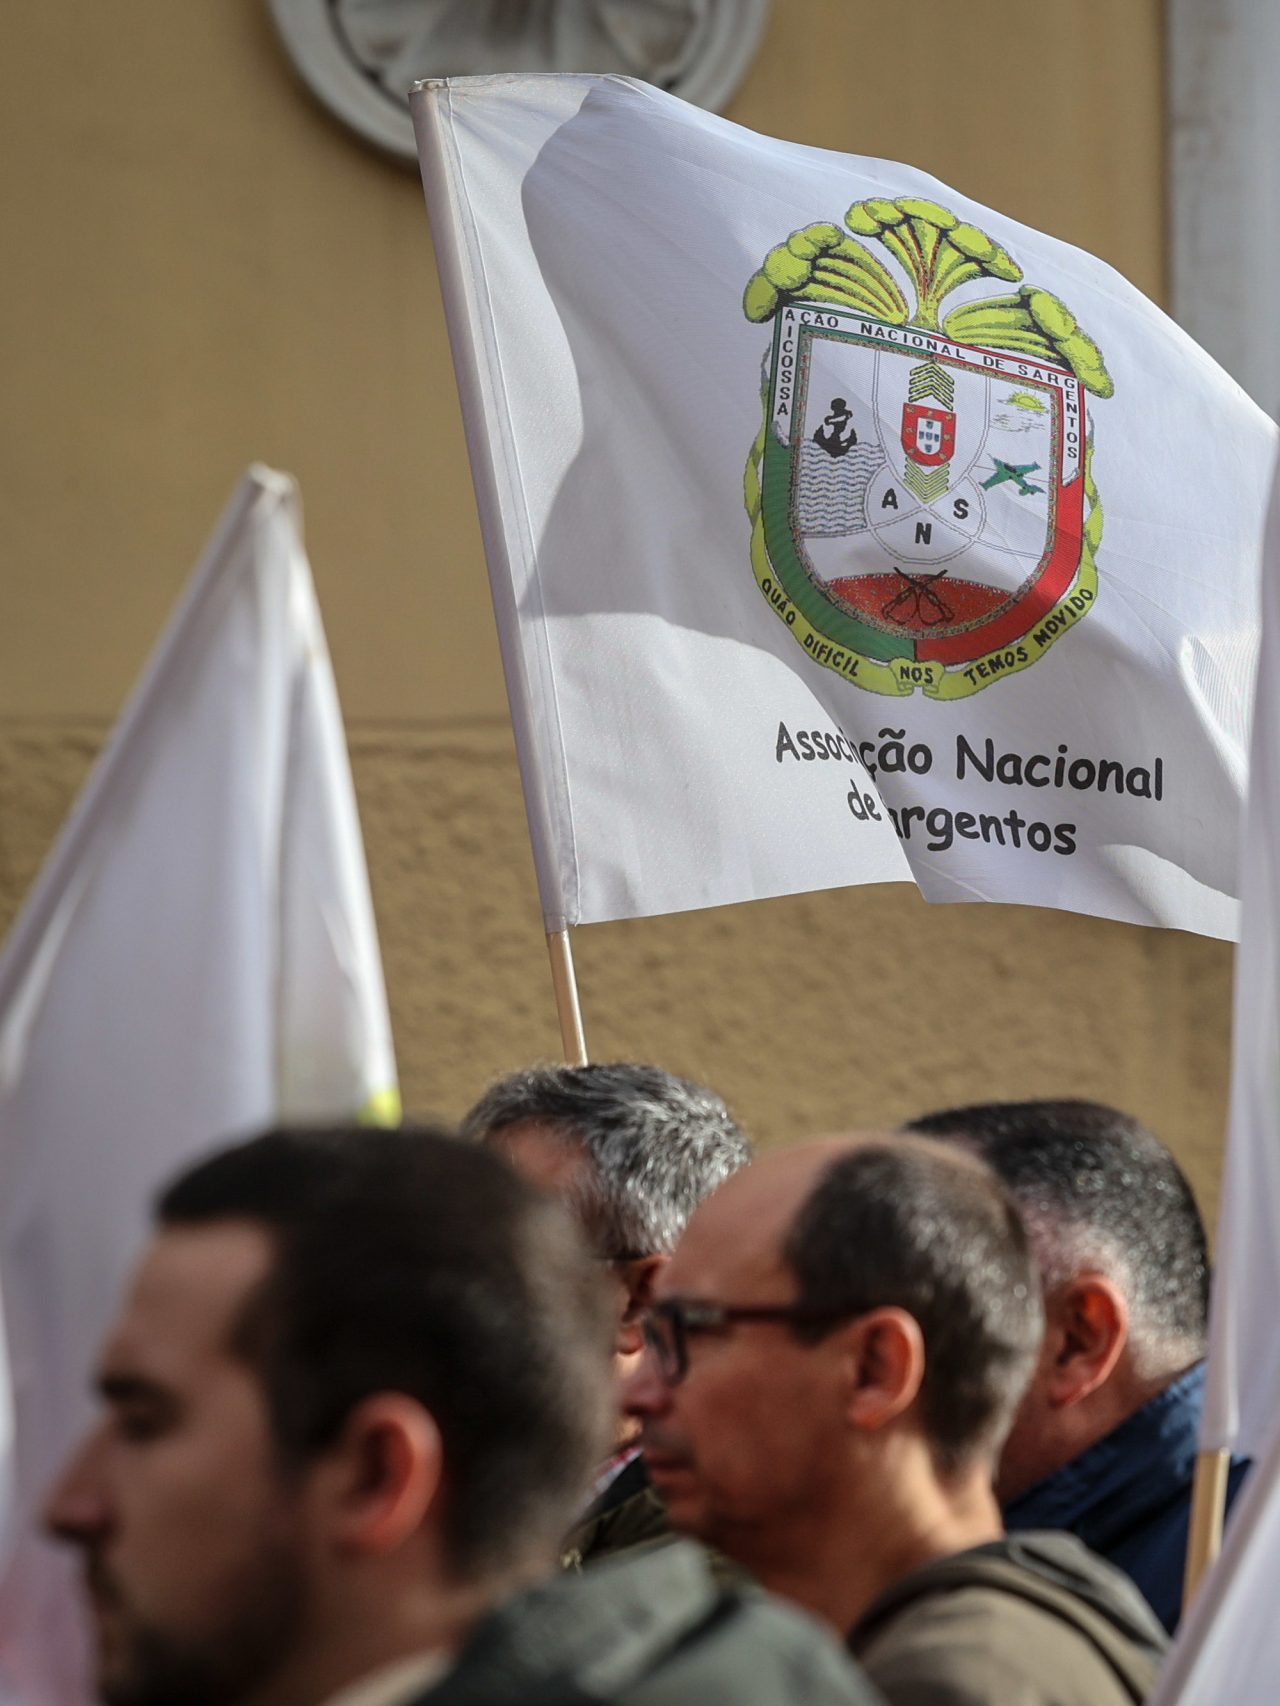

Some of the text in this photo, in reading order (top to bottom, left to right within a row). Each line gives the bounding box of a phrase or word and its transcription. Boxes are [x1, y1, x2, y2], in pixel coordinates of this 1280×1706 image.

[860, 322, 966, 360] NACIONAL
[982, 355, 1006, 371] DE
[881, 488, 899, 510] A
[953, 498, 969, 520] S
[914, 522, 932, 545] N
[803, 633, 859, 677] DIFICIL
[900, 666, 934, 684] NOS
[963, 646, 1028, 686] TEMOS
[1033, 587, 1094, 648] MOVIDO
[955, 734, 1164, 802] Nacional
[847, 778, 883, 822] de
